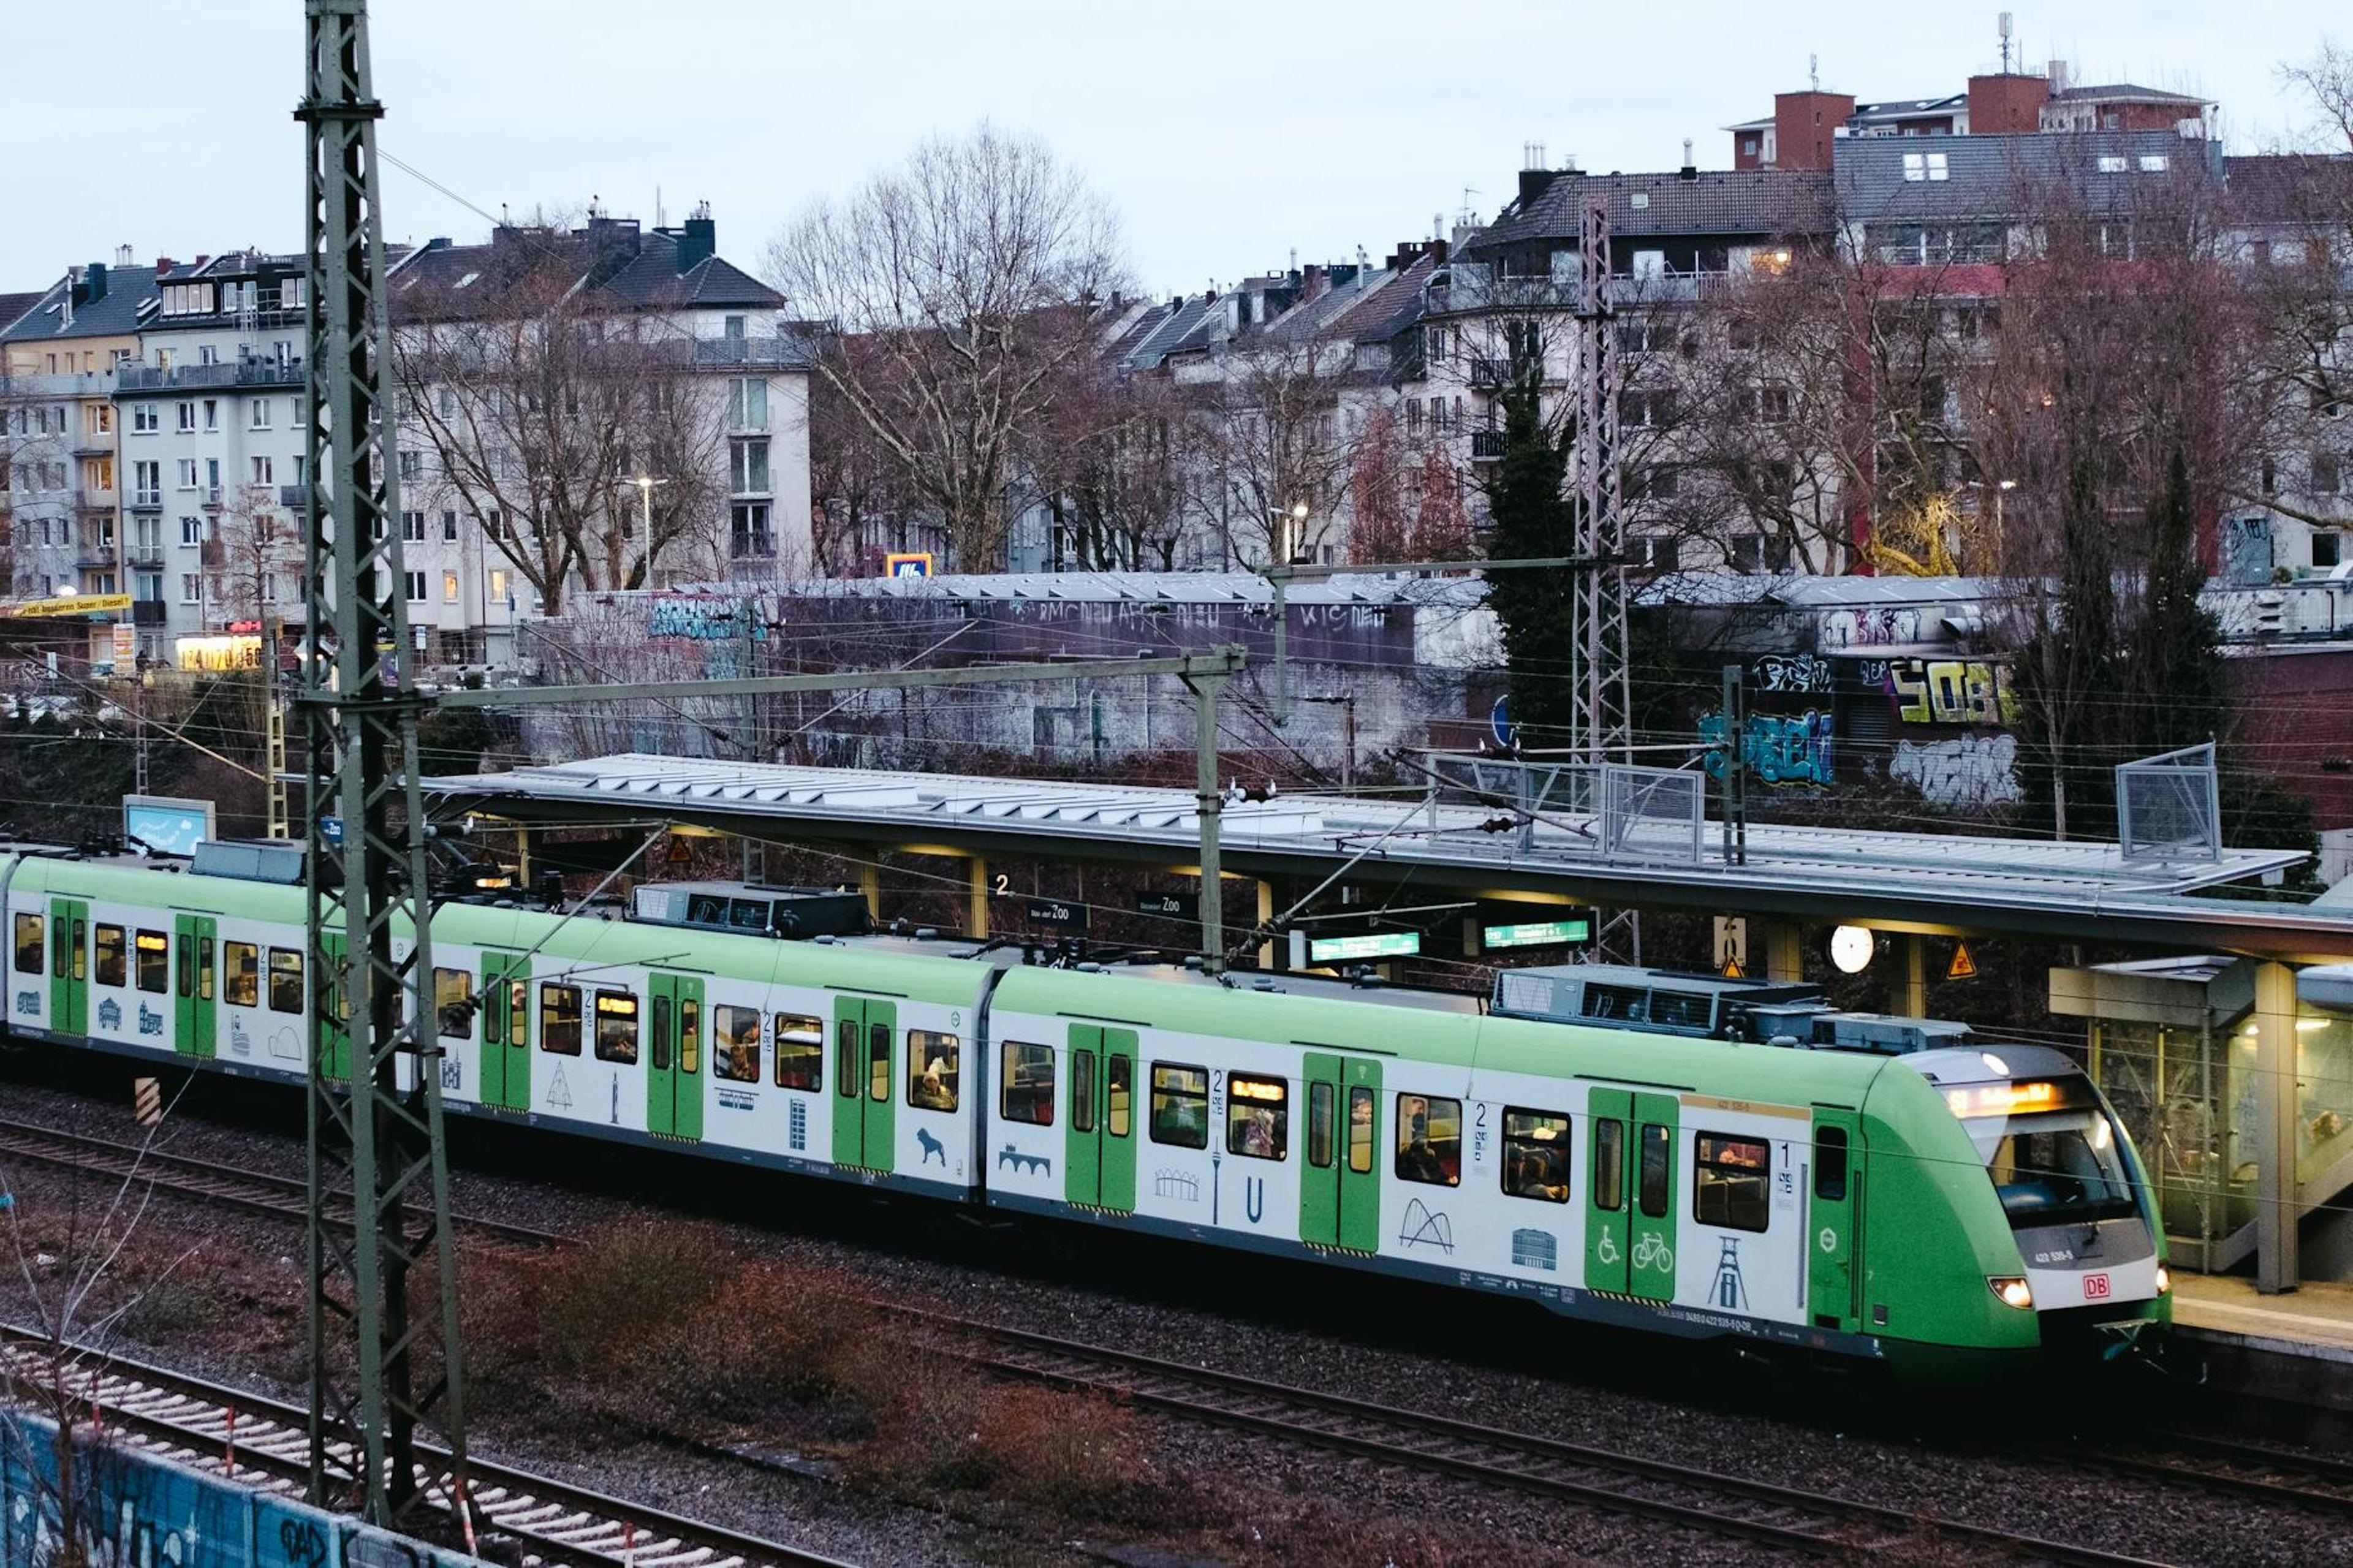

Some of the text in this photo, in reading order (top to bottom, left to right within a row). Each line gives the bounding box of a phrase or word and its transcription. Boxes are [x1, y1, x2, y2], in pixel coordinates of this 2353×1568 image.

[996, 874, 1008, 895] 2
[1051, 904, 1069, 920] Zoo
[1162, 897, 1180, 912] Zoo
[260, 945, 266, 964] 2
[585, 990, 591, 1008] 2
[764, 1012, 770, 1032] 2
[1214, 1070, 1222, 1093] 2
[1477, 1103, 1486, 1127] 2
[1782, 1143, 1788, 1168] 1
[1247, 1176, 1262, 1223] U
[2086, 1278, 2107, 1295] DB
